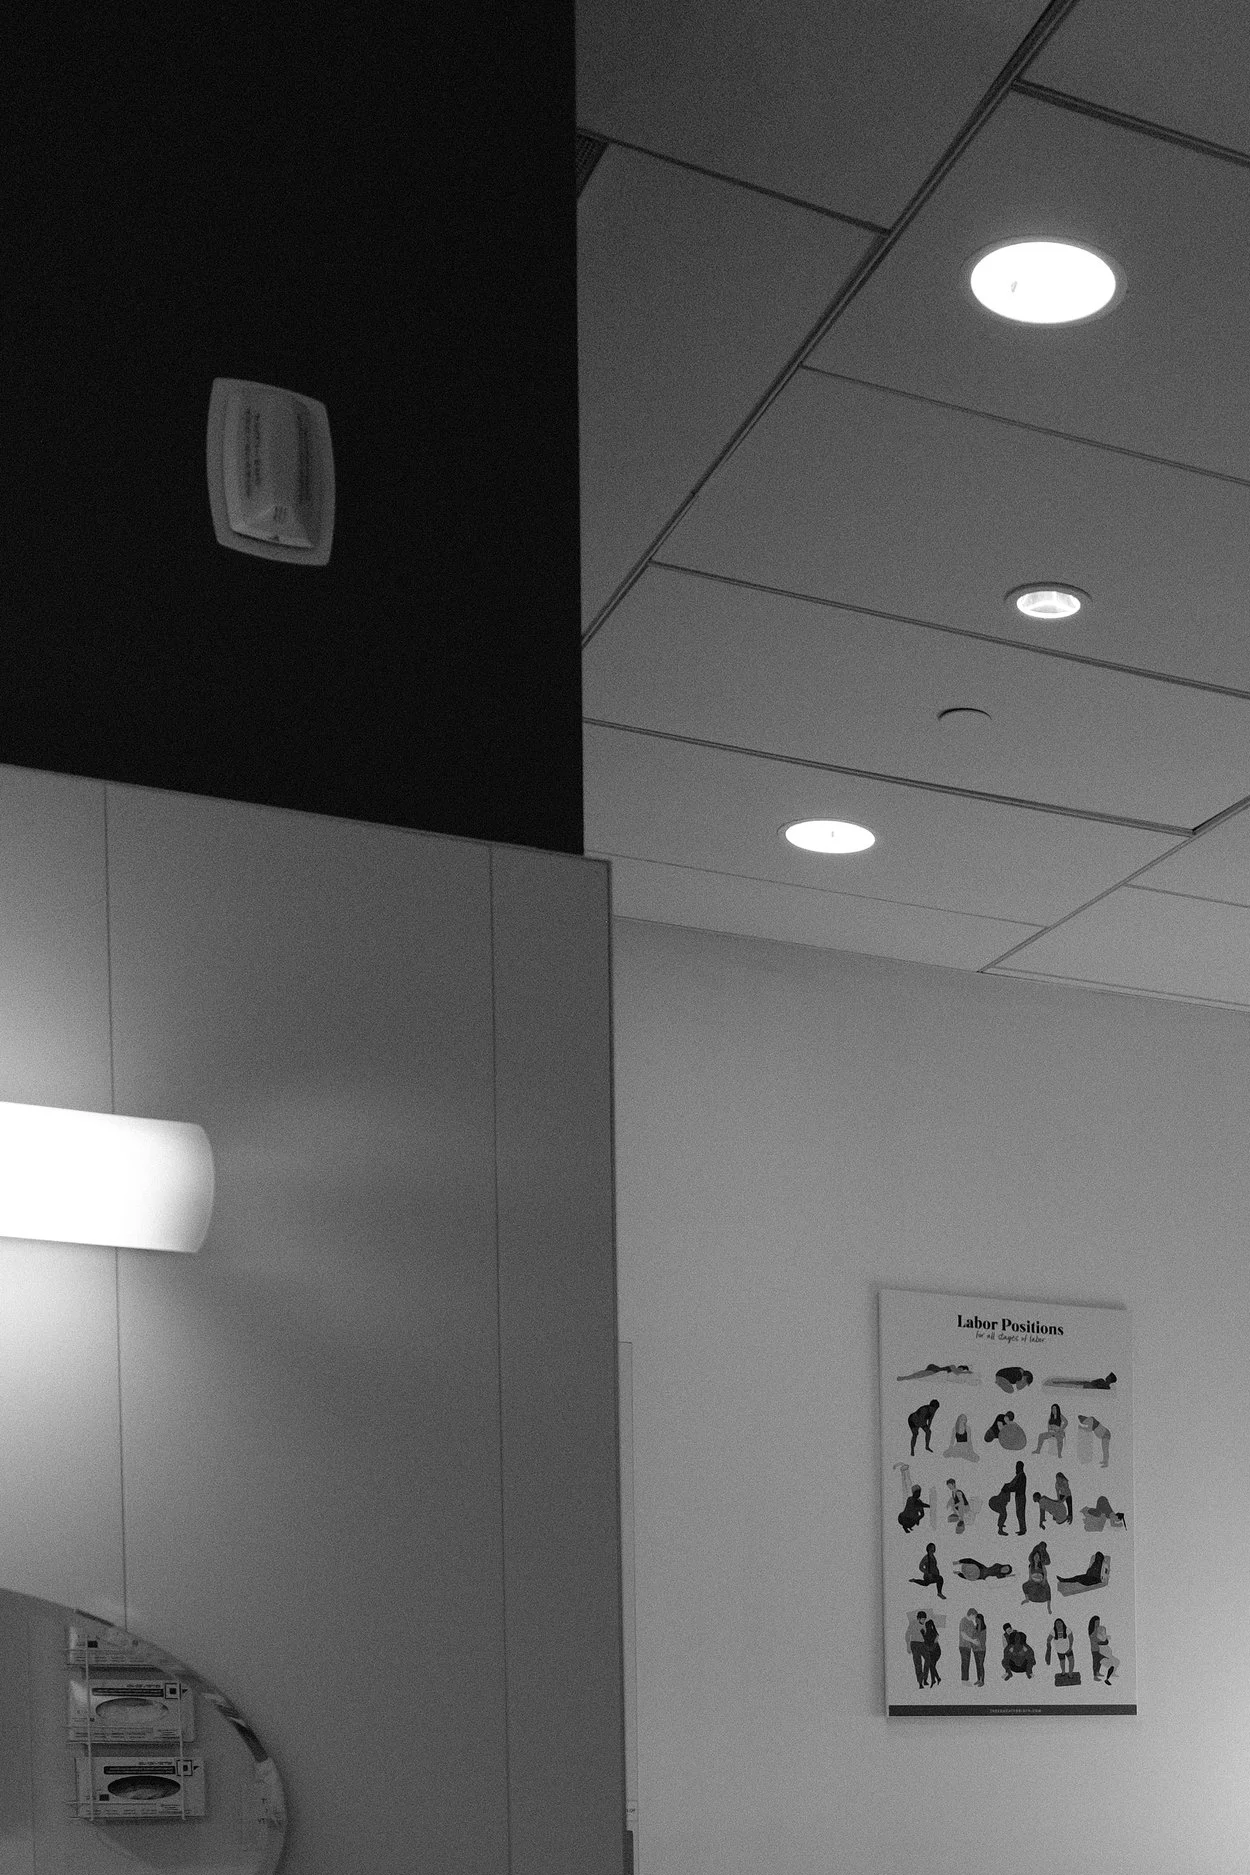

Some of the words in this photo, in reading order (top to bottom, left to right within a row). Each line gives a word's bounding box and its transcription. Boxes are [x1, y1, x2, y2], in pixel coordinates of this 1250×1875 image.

[957, 1314, 998, 1330] Labor
[1002, 1318, 1064, 1336] Positions
[998, 1332, 1019, 1344] stages
